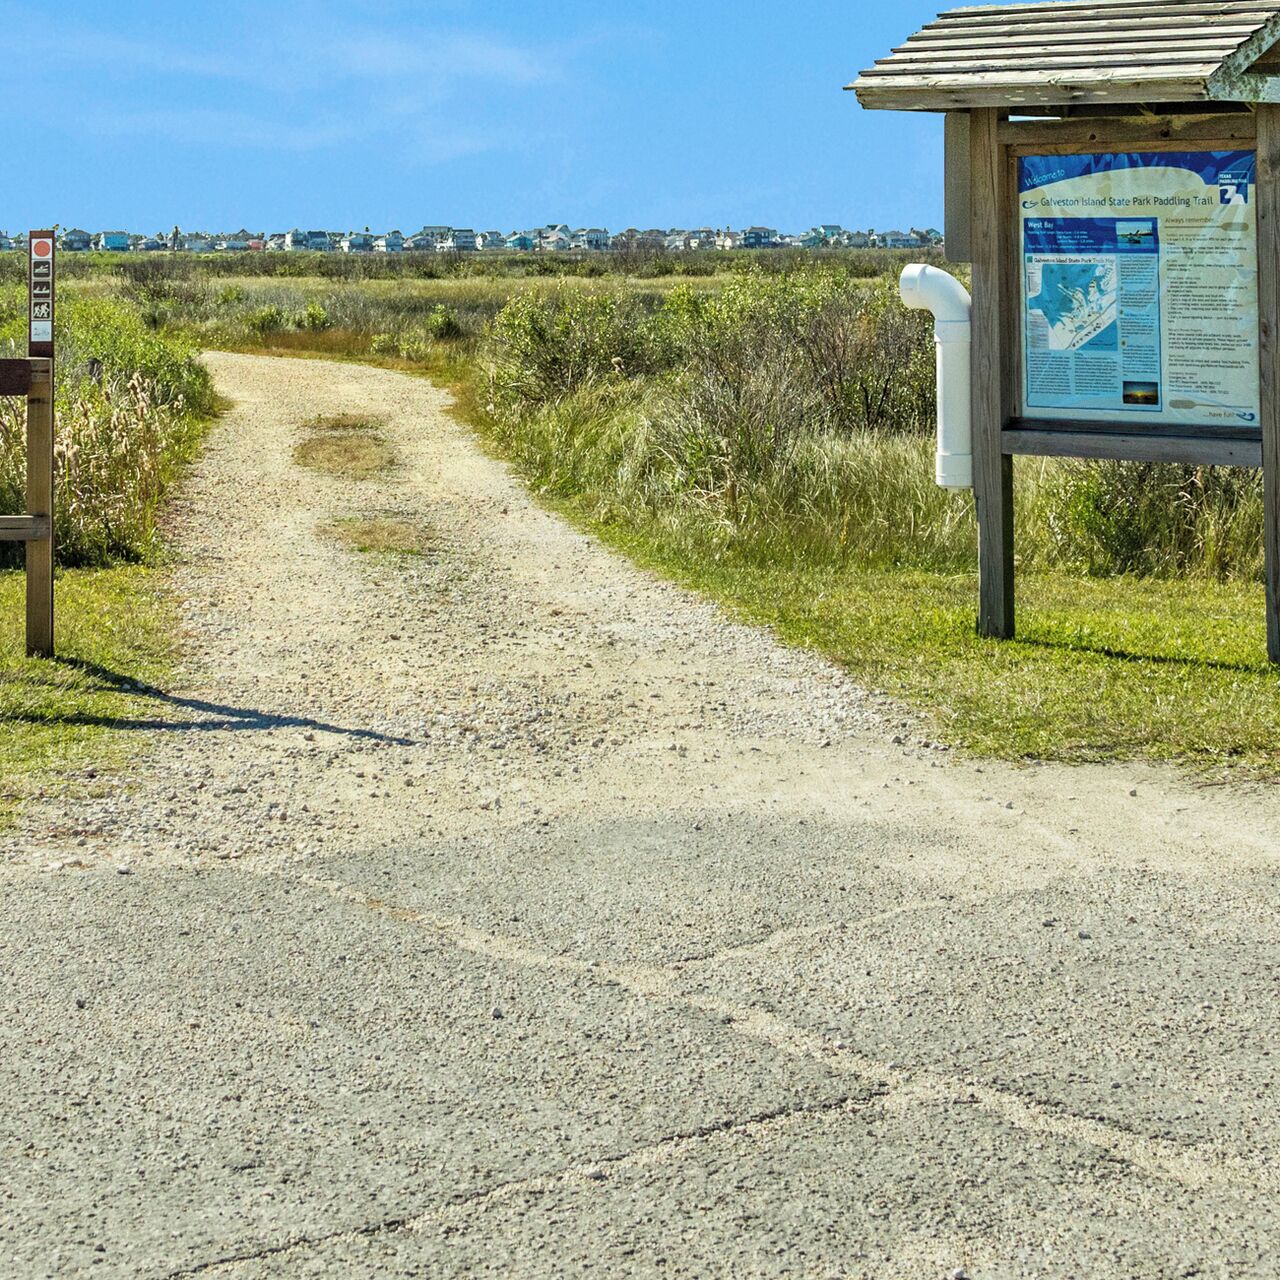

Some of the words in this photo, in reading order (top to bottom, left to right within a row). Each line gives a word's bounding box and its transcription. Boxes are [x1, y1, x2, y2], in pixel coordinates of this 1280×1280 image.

[1040, 197, 1079, 207] Galveston
[1081, 196, 1107, 207] Island
[1108, 197, 1131, 207] State
[1132, 196, 1151, 206] Park
[1153, 196, 1191, 208] Paddling
[1193, 196, 1214, 206] Trail
[1044, 221, 1054, 230] Bay
